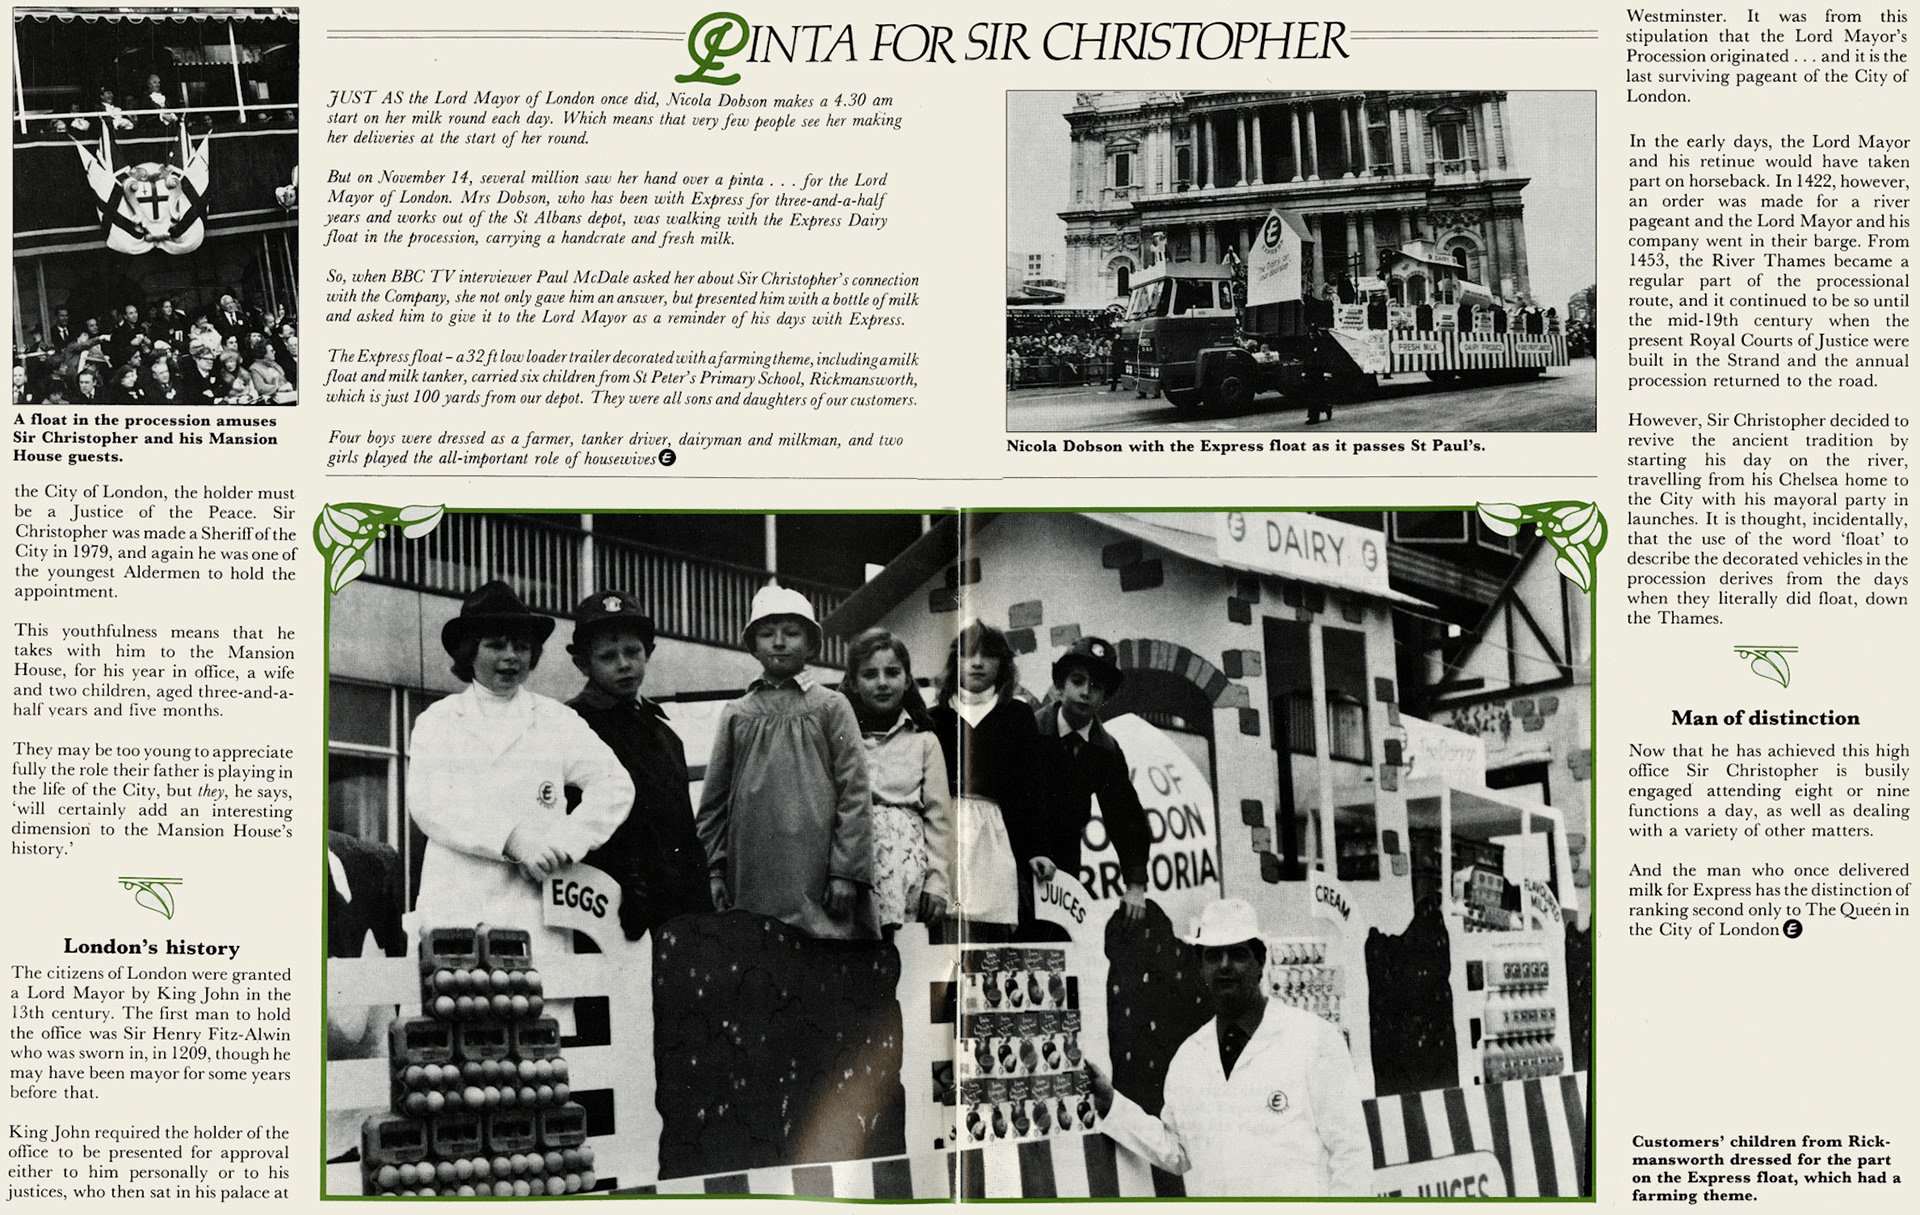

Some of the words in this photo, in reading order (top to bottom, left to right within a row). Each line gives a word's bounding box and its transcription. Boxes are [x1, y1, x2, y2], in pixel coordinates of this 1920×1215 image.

[1626, 8, 1727, 23] Westminster.
[1747, 8, 1760, 23] It
[1778, 13, 1807, 23] was
[1825, 8, 1862, 23] from
[1880, 8, 1908, 23] this
[869, 24, 956, 63] FOR
[964, 22, 1031, 63] SIR
[1042, 21, 1351, 62] CHRISTOPHER
[326, 89, 378, 108] JUST
[381, 90, 405, 105] AS
[408, 90, 429, 105] the
[434, 90, 469, 105] Lord
[473, 90, 521, 109] Mayor
[525, 90, 543, 109] of
[545, 90, 595, 105] London
[600, 95, 629, 105] once
[633, 91, 660, 108] did,
[665, 91, 712, 107] Nicola
[717, 93, 768, 108] Dobson
[773, 93, 814, 108] makes
[819, 98, 828, 108] a
[834, 92, 867, 107] 4.30
[872, 96, 893, 107] am
[1626, 88, 1691, 103] London.
[1398, 343, 1421, 351] FRESH
[1423, 343, 1438, 351] MILK
[1464, 343, 1479, 352] DAIRY
[1481, 343, 1503, 352] PRODUCE
[13, 412, 26, 425] A
[30, 412, 68, 426] float
[72, 412, 89, 426] in
[94, 413, 120, 426] the
[124, 413, 211, 430] procession
[216, 417, 277, 427] amuses
[13, 430, 37, 444] Sir
[41, 430, 139, 448] Christopher
[144, 431, 174, 445] and
[179, 431, 204, 445] his
[208, 432, 278, 446] Mansion
[1006, 439, 1058, 453] Nicola
[1062, 439, 1123, 453] Dobson
[1128, 439, 1165, 453] with
[1169, 439, 1195, 453] the
[1200, 439, 1264, 456] Express
[1269, 438, 1307, 452] float
[1312, 442, 1330, 452] as
[1335, 438, 1347, 452] it
[1352, 442, 1406, 456] passes
[1411, 438, 1427, 452] St
[1432, 438, 1486, 452] Paul’s.
[12, 448, 63, 462] House
[67, 451, 124, 466] guests.
[326, 449, 359, 468] girls
[362, 449, 409, 468] played
[413, 449, 434, 464] the
[438, 450, 528, 469] all-important
[534, 450, 560, 465] role
[564, 450, 582, 469] of
[584, 450, 657, 467] housewives
[14, 483, 39, 498] the
[44, 483, 78, 502] City
[83, 484, 100, 498] of
[103, 484, 168, 502] London,
[174, 484, 198, 499] the
[203, 484, 254, 500] holder
[257, 488, 295, 500] must
[1266, 519, 1345, 567] DAIRY
[1627, 610, 1651, 625] the
[1657, 610, 1723, 625] Thames.
[1671, 709, 1719, 727] Man
[1723, 709, 1746, 726] of
[1748, 709, 1861, 726] distinction
[1629, 743, 1666, 758] Now
[1672, 743, 1704, 758] that
[1711, 743, 1729, 758] he
[1736, 743, 1762, 758] has
[1767, 743, 1836, 758] achieved
[1842, 743, 1870, 758] this
[1875, 743, 1910, 762] high
[1147, 763, 1183, 797] OF
[1081, 802, 1207, 852] ODON
[551, 878, 609, 919] EGGS
[1040, 882, 1087, 925] JUICES
[1315, 884, 1351, 922] CREAM
[1530, 894, 1549, 918] MILK
[1628, 921, 1653, 937] the
[1659, 921, 1693, 940] City
[1698, 921, 1716, 936] of
[1719, 920, 1780, 936] London
[63, 937, 159, 955] London’s
[165, 938, 241, 961] history
[10, 965, 42, 980] The
[46, 965, 104, 980] citizens
[107, 965, 125, 980] of
[126, 965, 187, 981] London
[191, 970, 228, 981] were
[231, 967, 292, 985] granted
[1632, 1134, 1725, 1148] Customers’
[1729, 1134, 1797, 1148] children
[1801, 1134, 1843, 1148] from
[1848, 1134, 1891, 1148] Rick-
[1632, 1152, 1725, 1166] mansworth
[1729, 1152, 1792, 1166] dressed
[1797, 1152, 1822, 1166] for
[1826, 1152, 1852, 1166] the
[1857, 1155, 1892, 1170] part
[1631, 1174, 1652, 1184] on
[1656, 1170, 1682, 1184] the
[1687, 1170, 1752, 1187] Express
[1756, 1170, 1799, 1186] float,
[1803, 1170, 1852, 1184] which
[1857, 1170, 1887, 1184] had
[1892, 1174, 1902, 1184] a
[5, 1183, 68, 1202] justices,
[73, 1184, 106, 1198] who
[111, 1184, 145, 1199] then
[150, 1187, 171, 1199] sat
[176, 1184, 191, 1199] in
[195, 1184, 217, 1199] his
[220, 1184, 270, 1203] palace
[273, 1188, 289, 1199] at
[1632, 1188, 1698, 1206] farming
[1703, 1188, 1758, 1202] theme.
